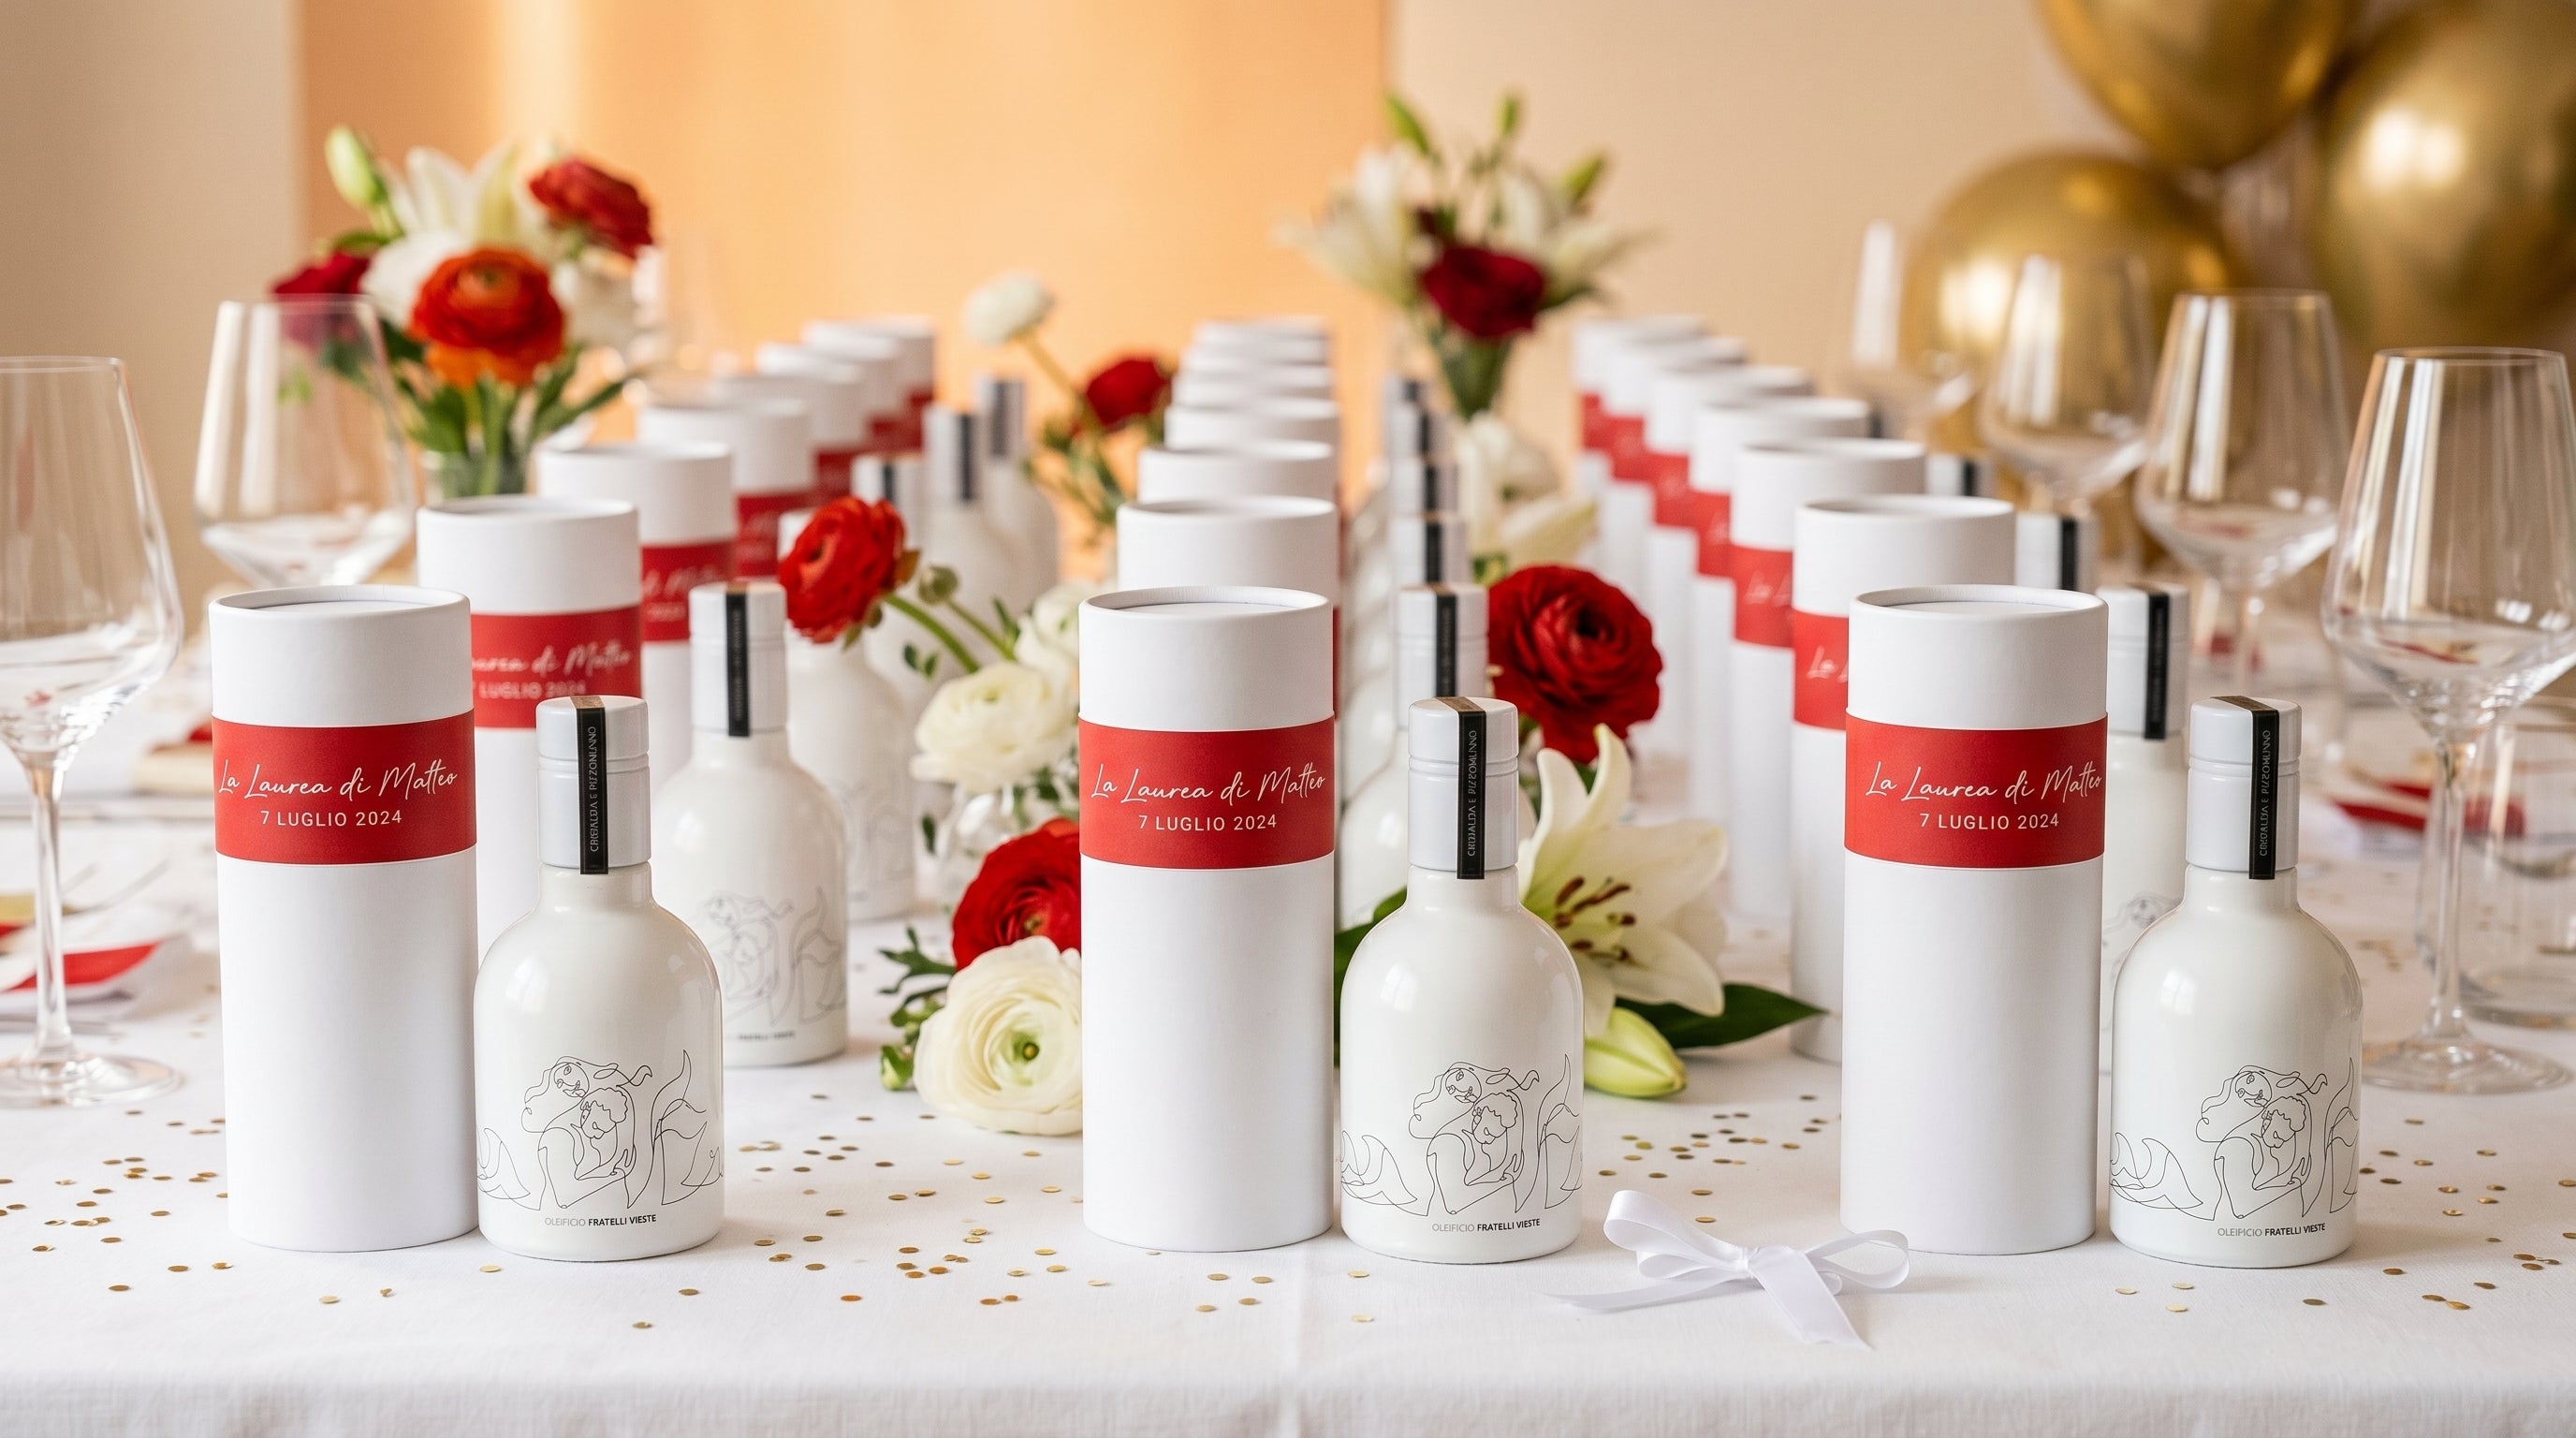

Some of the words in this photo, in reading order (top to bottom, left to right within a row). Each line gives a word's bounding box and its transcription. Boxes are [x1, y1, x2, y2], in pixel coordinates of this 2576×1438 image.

[218, 759, 240, 794] La
[243, 764, 332, 800] Laurea
[340, 768, 371, 801] di
[378, 758, 457, 800] Matteo
[1090, 764, 1118, 799] La
[1120, 768, 1213, 804] Laurea
[1220, 771, 1251, 806] di
[1257, 762, 1325, 804] Matteo
[1866, 761, 1897, 797] La
[1901, 766, 1998, 802] Laurea
[2004, 770, 2035, 805] di
[2041, 760, 2102, 803] Matteo
[260, 810, 270, 825] 7
[277, 811, 347, 827] LUGLIO
[356, 809, 402, 826] 2024
[1138, 814, 1149, 829] 7
[1155, 815, 1225, 831] LUGLIO
[1234, 814, 1278, 830] 2024
[1919, 813, 1929, 828] 7
[1938, 814, 2009, 830] LUGLIO
[2017, 812, 2059, 829] 2024
[544, 1217, 586, 1226] OLEIFICIO
[588, 1217, 627, 1226] FRATELLI
[629, 1214, 657, 1225] VIESTE
[1431, 1223, 1475, 1232] OLEIFICIO
[1477, 1222, 1515, 1232] FRATELLI
[1516, 1218, 1541, 1229] VIESTE
[2264, 1226, 2302, 1237] FRATELLI
[2303, 1223, 2326, 1234] VIESTE
